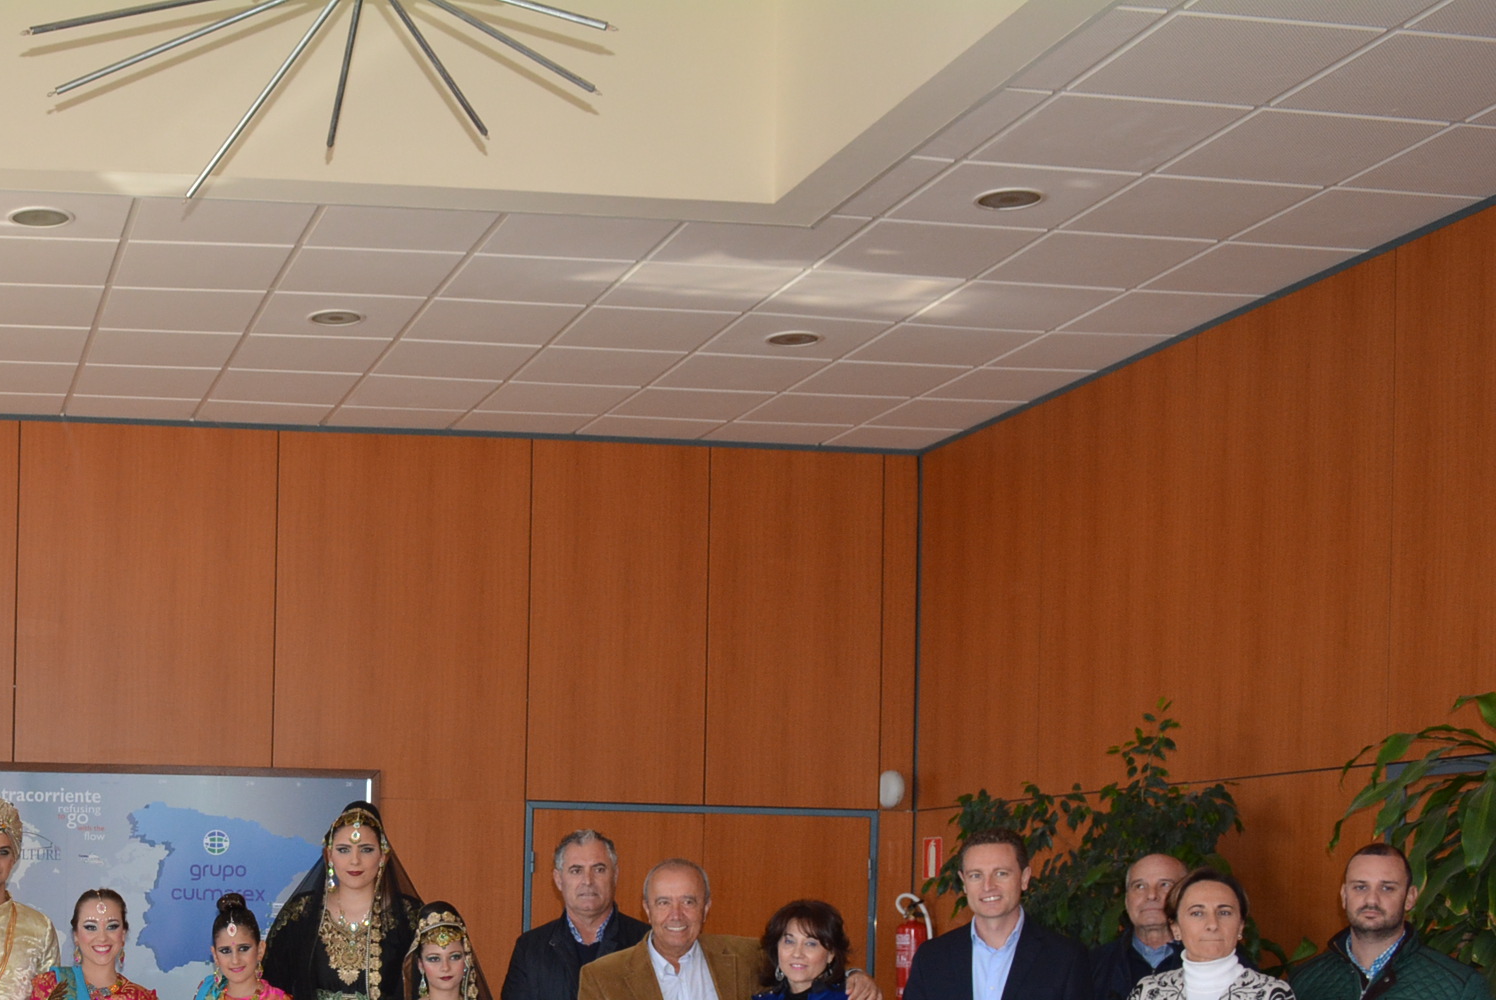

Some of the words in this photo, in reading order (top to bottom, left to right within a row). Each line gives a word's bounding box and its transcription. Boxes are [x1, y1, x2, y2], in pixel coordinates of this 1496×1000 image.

[57, 804, 101, 816] refusing
[67, 812, 89, 829] go
[84, 831, 105, 841] flow
[189, 863, 247, 881] grupo
